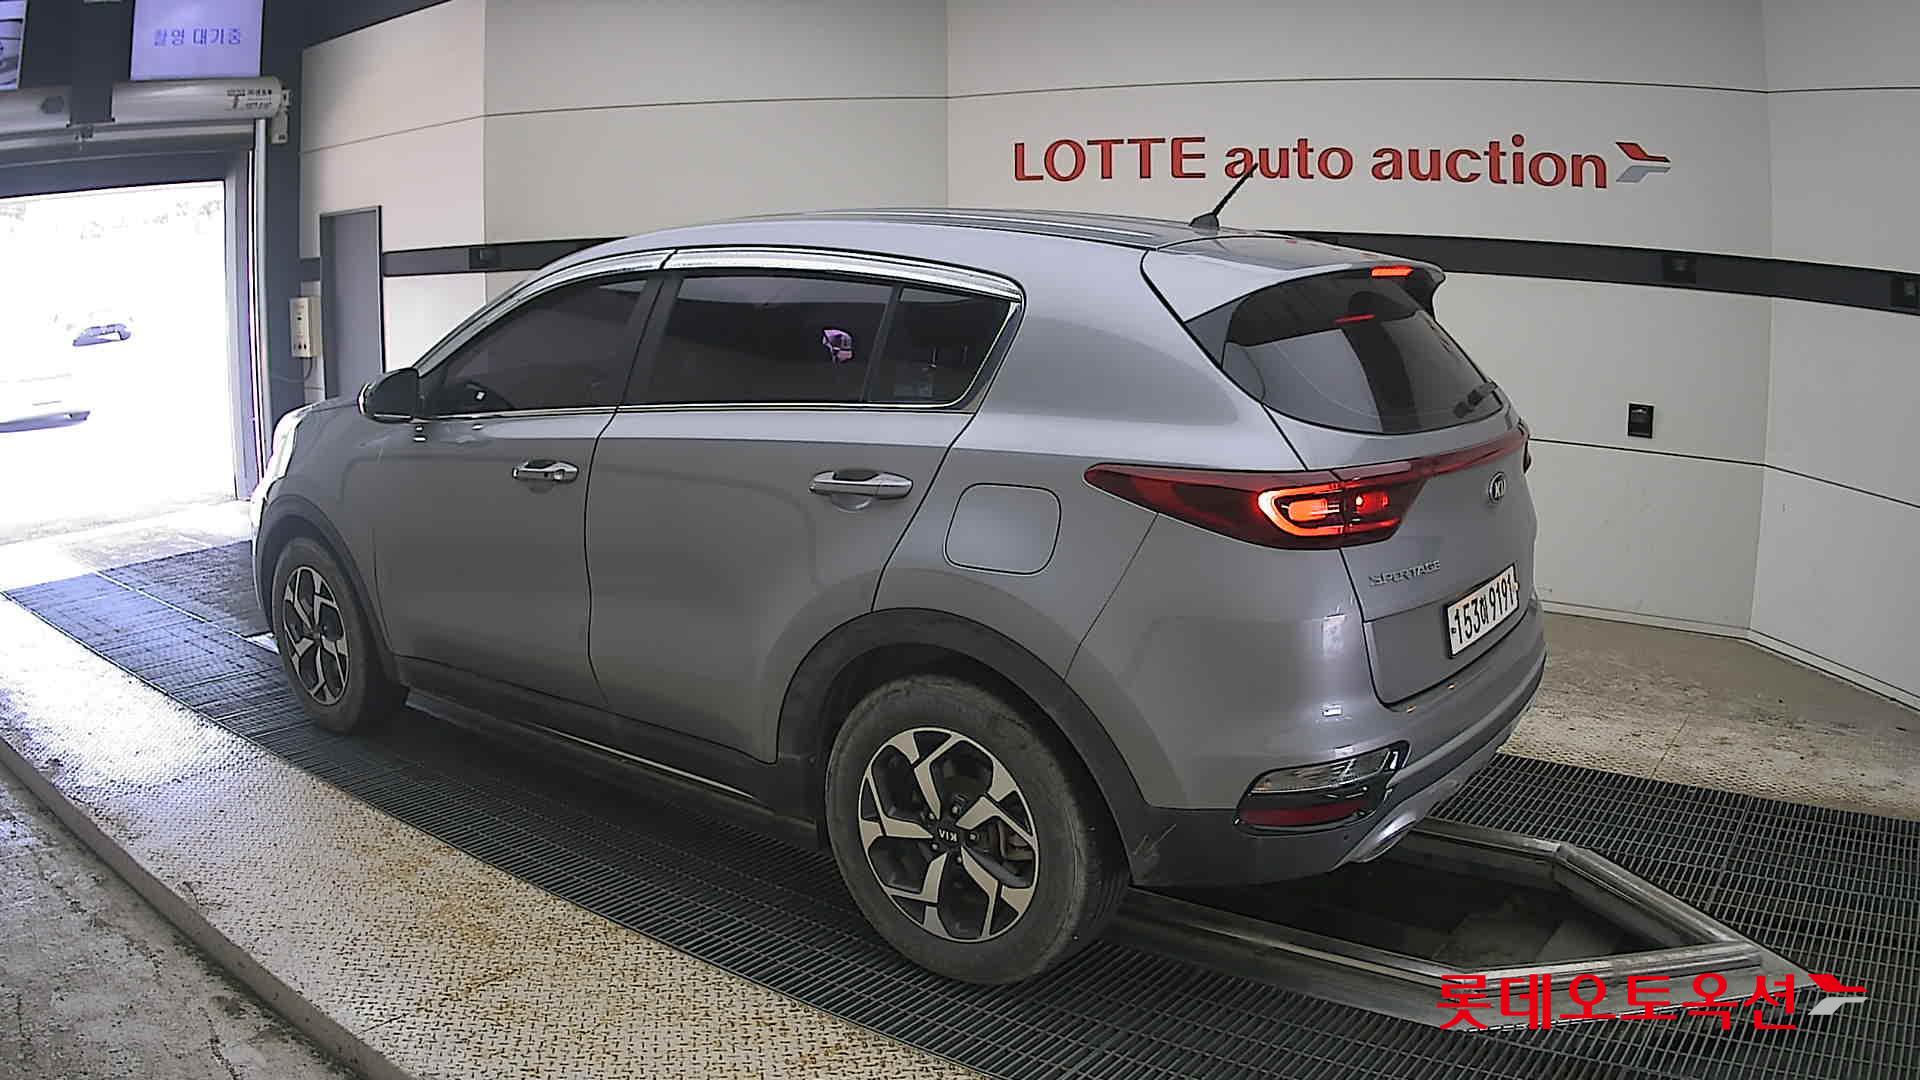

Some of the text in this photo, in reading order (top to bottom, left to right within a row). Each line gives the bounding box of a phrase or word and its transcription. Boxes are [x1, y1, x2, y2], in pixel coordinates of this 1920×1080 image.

[192, 28, 241, 46] 대기중
[1014, 135, 1607, 188] LOTTE auto auction
